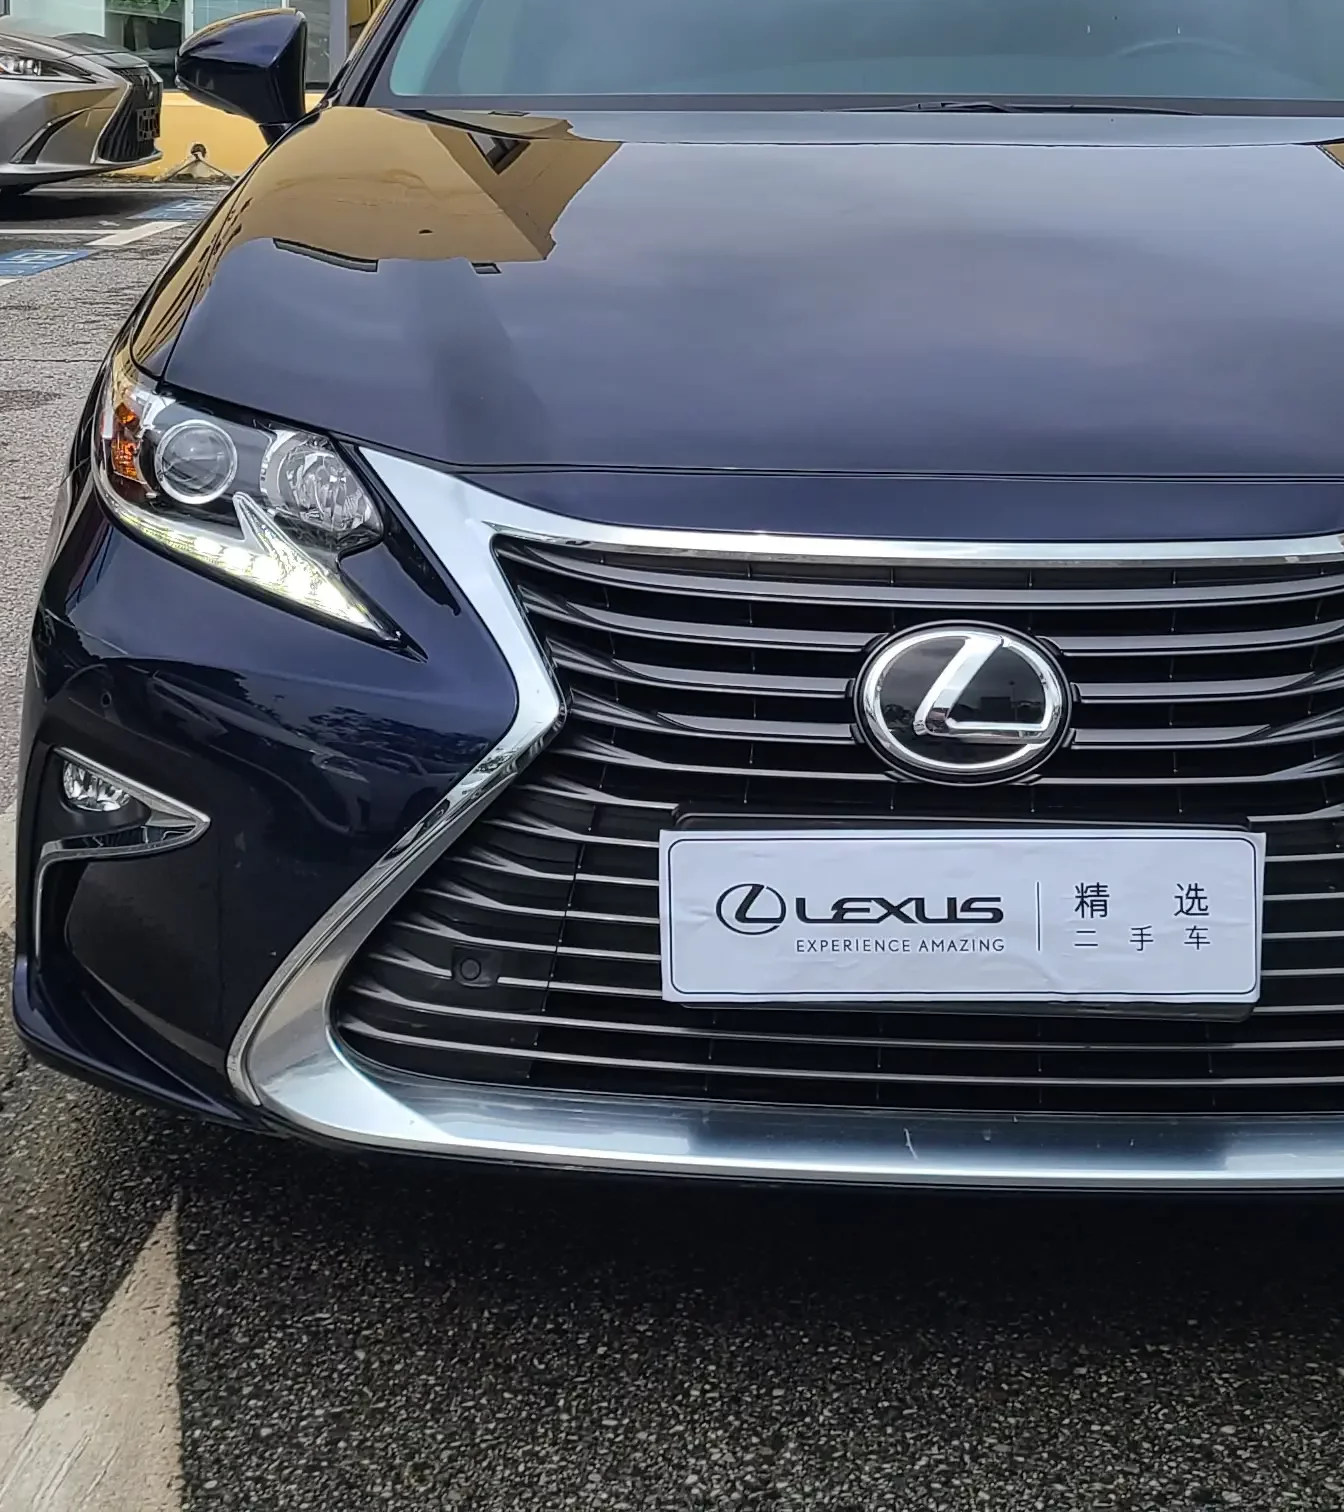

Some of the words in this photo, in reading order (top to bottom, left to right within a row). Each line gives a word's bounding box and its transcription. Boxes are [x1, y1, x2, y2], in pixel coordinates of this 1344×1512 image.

[795, 896, 1004, 924] LEXUS
[1074, 881, 1210, 919] 精选
[796, 938, 911, 953] EXPERIENCE
[918, 938, 1005, 953] AMAZING
[1074, 925, 1211, 952] 二手车
